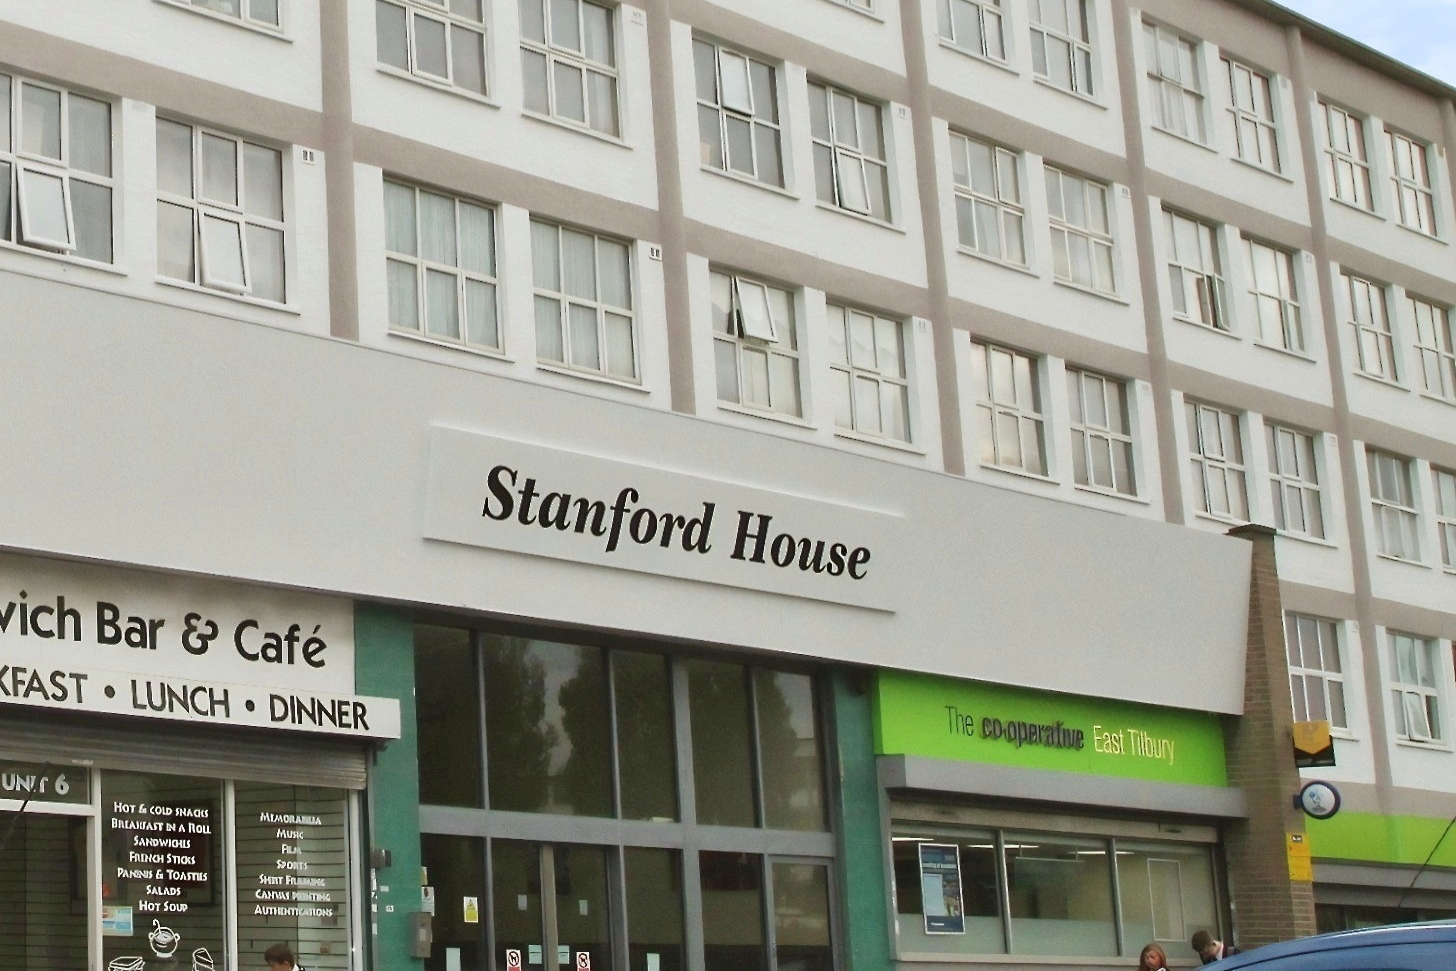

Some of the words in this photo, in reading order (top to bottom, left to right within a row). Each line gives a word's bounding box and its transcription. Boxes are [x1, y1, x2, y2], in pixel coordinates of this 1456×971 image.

[481, 464, 717, 554] Stanford
[730, 509, 873, 581] House
[96, 601, 166, 650] Bar
[181, 612, 219, 655] &
[234, 618, 328, 669] Café
[130, 679, 230, 719] LUNCH
[269, 693, 370, 731] DINNER
[945, 705, 974, 737] The
[1093, 725, 1125, 756] East
[1127, 728, 1175, 766] Tilbury
[1, 772, 49, 794] UNIT
[54, 773, 70, 795] 6
[113, 801, 136, 814] HOT
[138, 804, 147, 814] &
[149, 805, 173, 815] COLD
[175, 807, 209, 818] SNACKS
[166, 823, 176, 832] IN
[178, 825, 186, 833] A
[156, 869, 164, 880] &
[139, 900, 161, 912] HOT
[163, 900, 188, 912] SOUP
